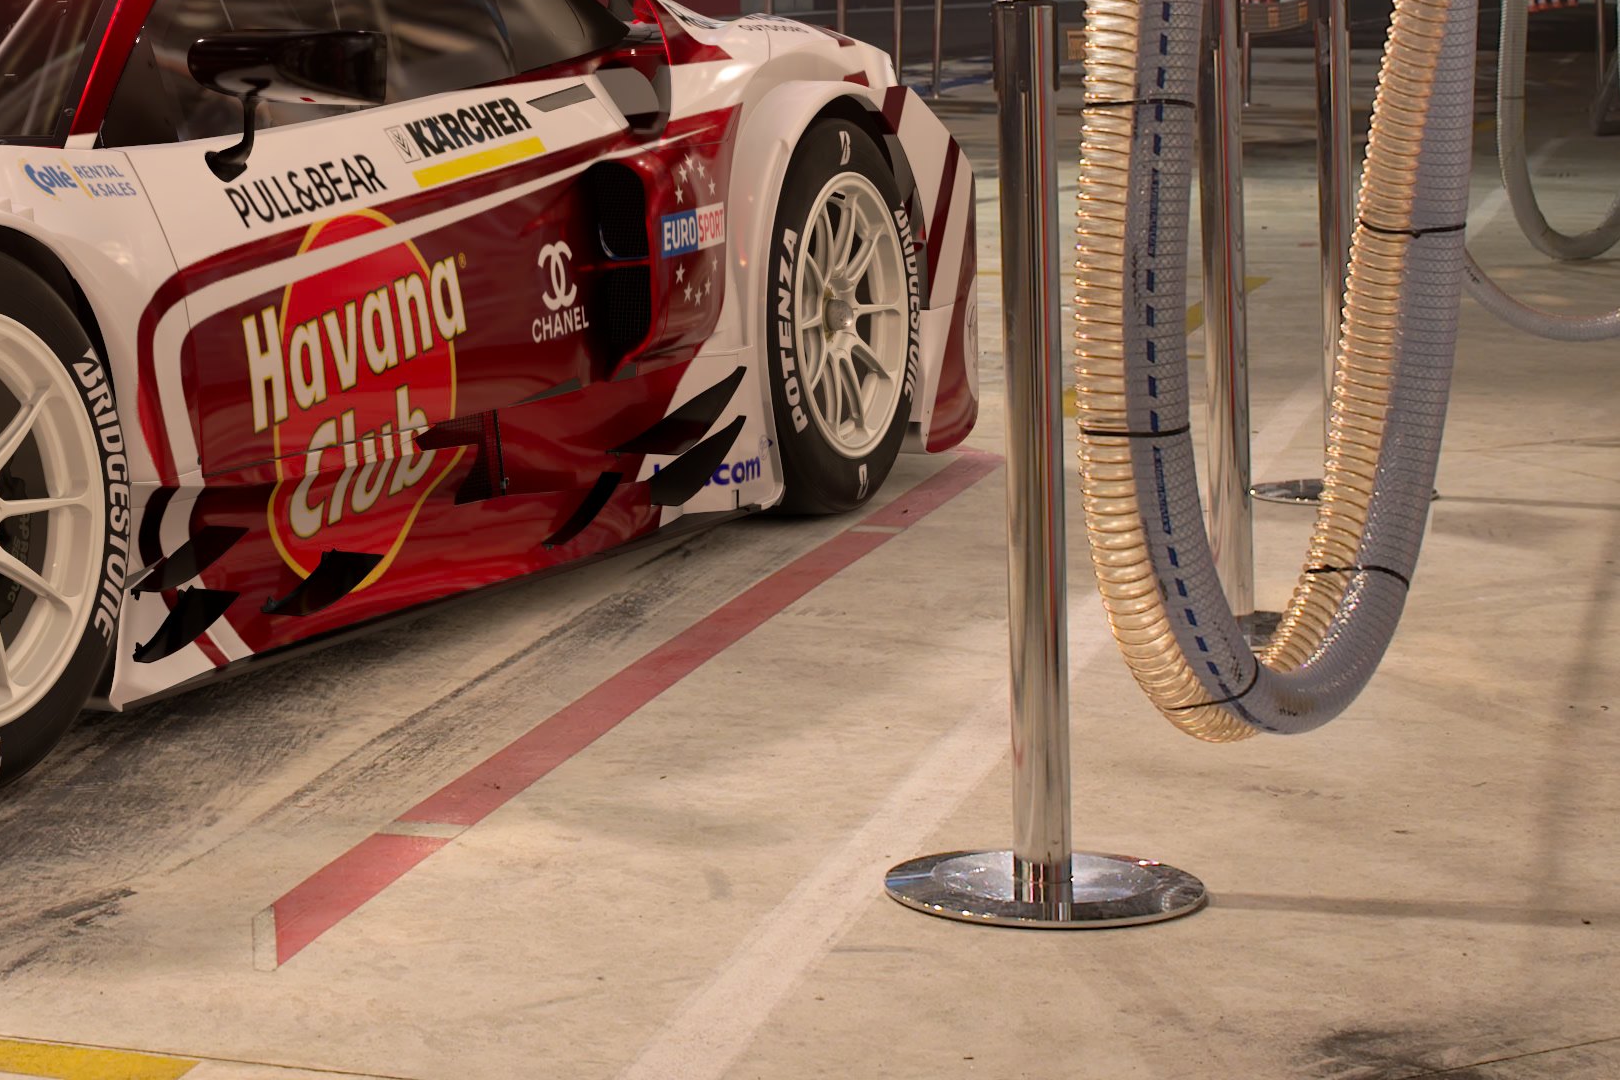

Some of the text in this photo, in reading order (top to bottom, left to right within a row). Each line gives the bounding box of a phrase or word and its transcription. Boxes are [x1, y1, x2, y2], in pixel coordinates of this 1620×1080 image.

[405, 97, 532, 158] KÄRCHER
[73, 164, 124, 180] RENTAL
[100, 182, 137, 197] SALES
[224, 154, 387, 228] PULL&BEAR
[242, 255, 468, 434] Havana
[532, 305, 590, 344] CHANEL
[777, 228, 809, 434] POTENZA
[73, 347, 131, 648] BRIDGESTONE
[288, 384, 435, 540] Club
